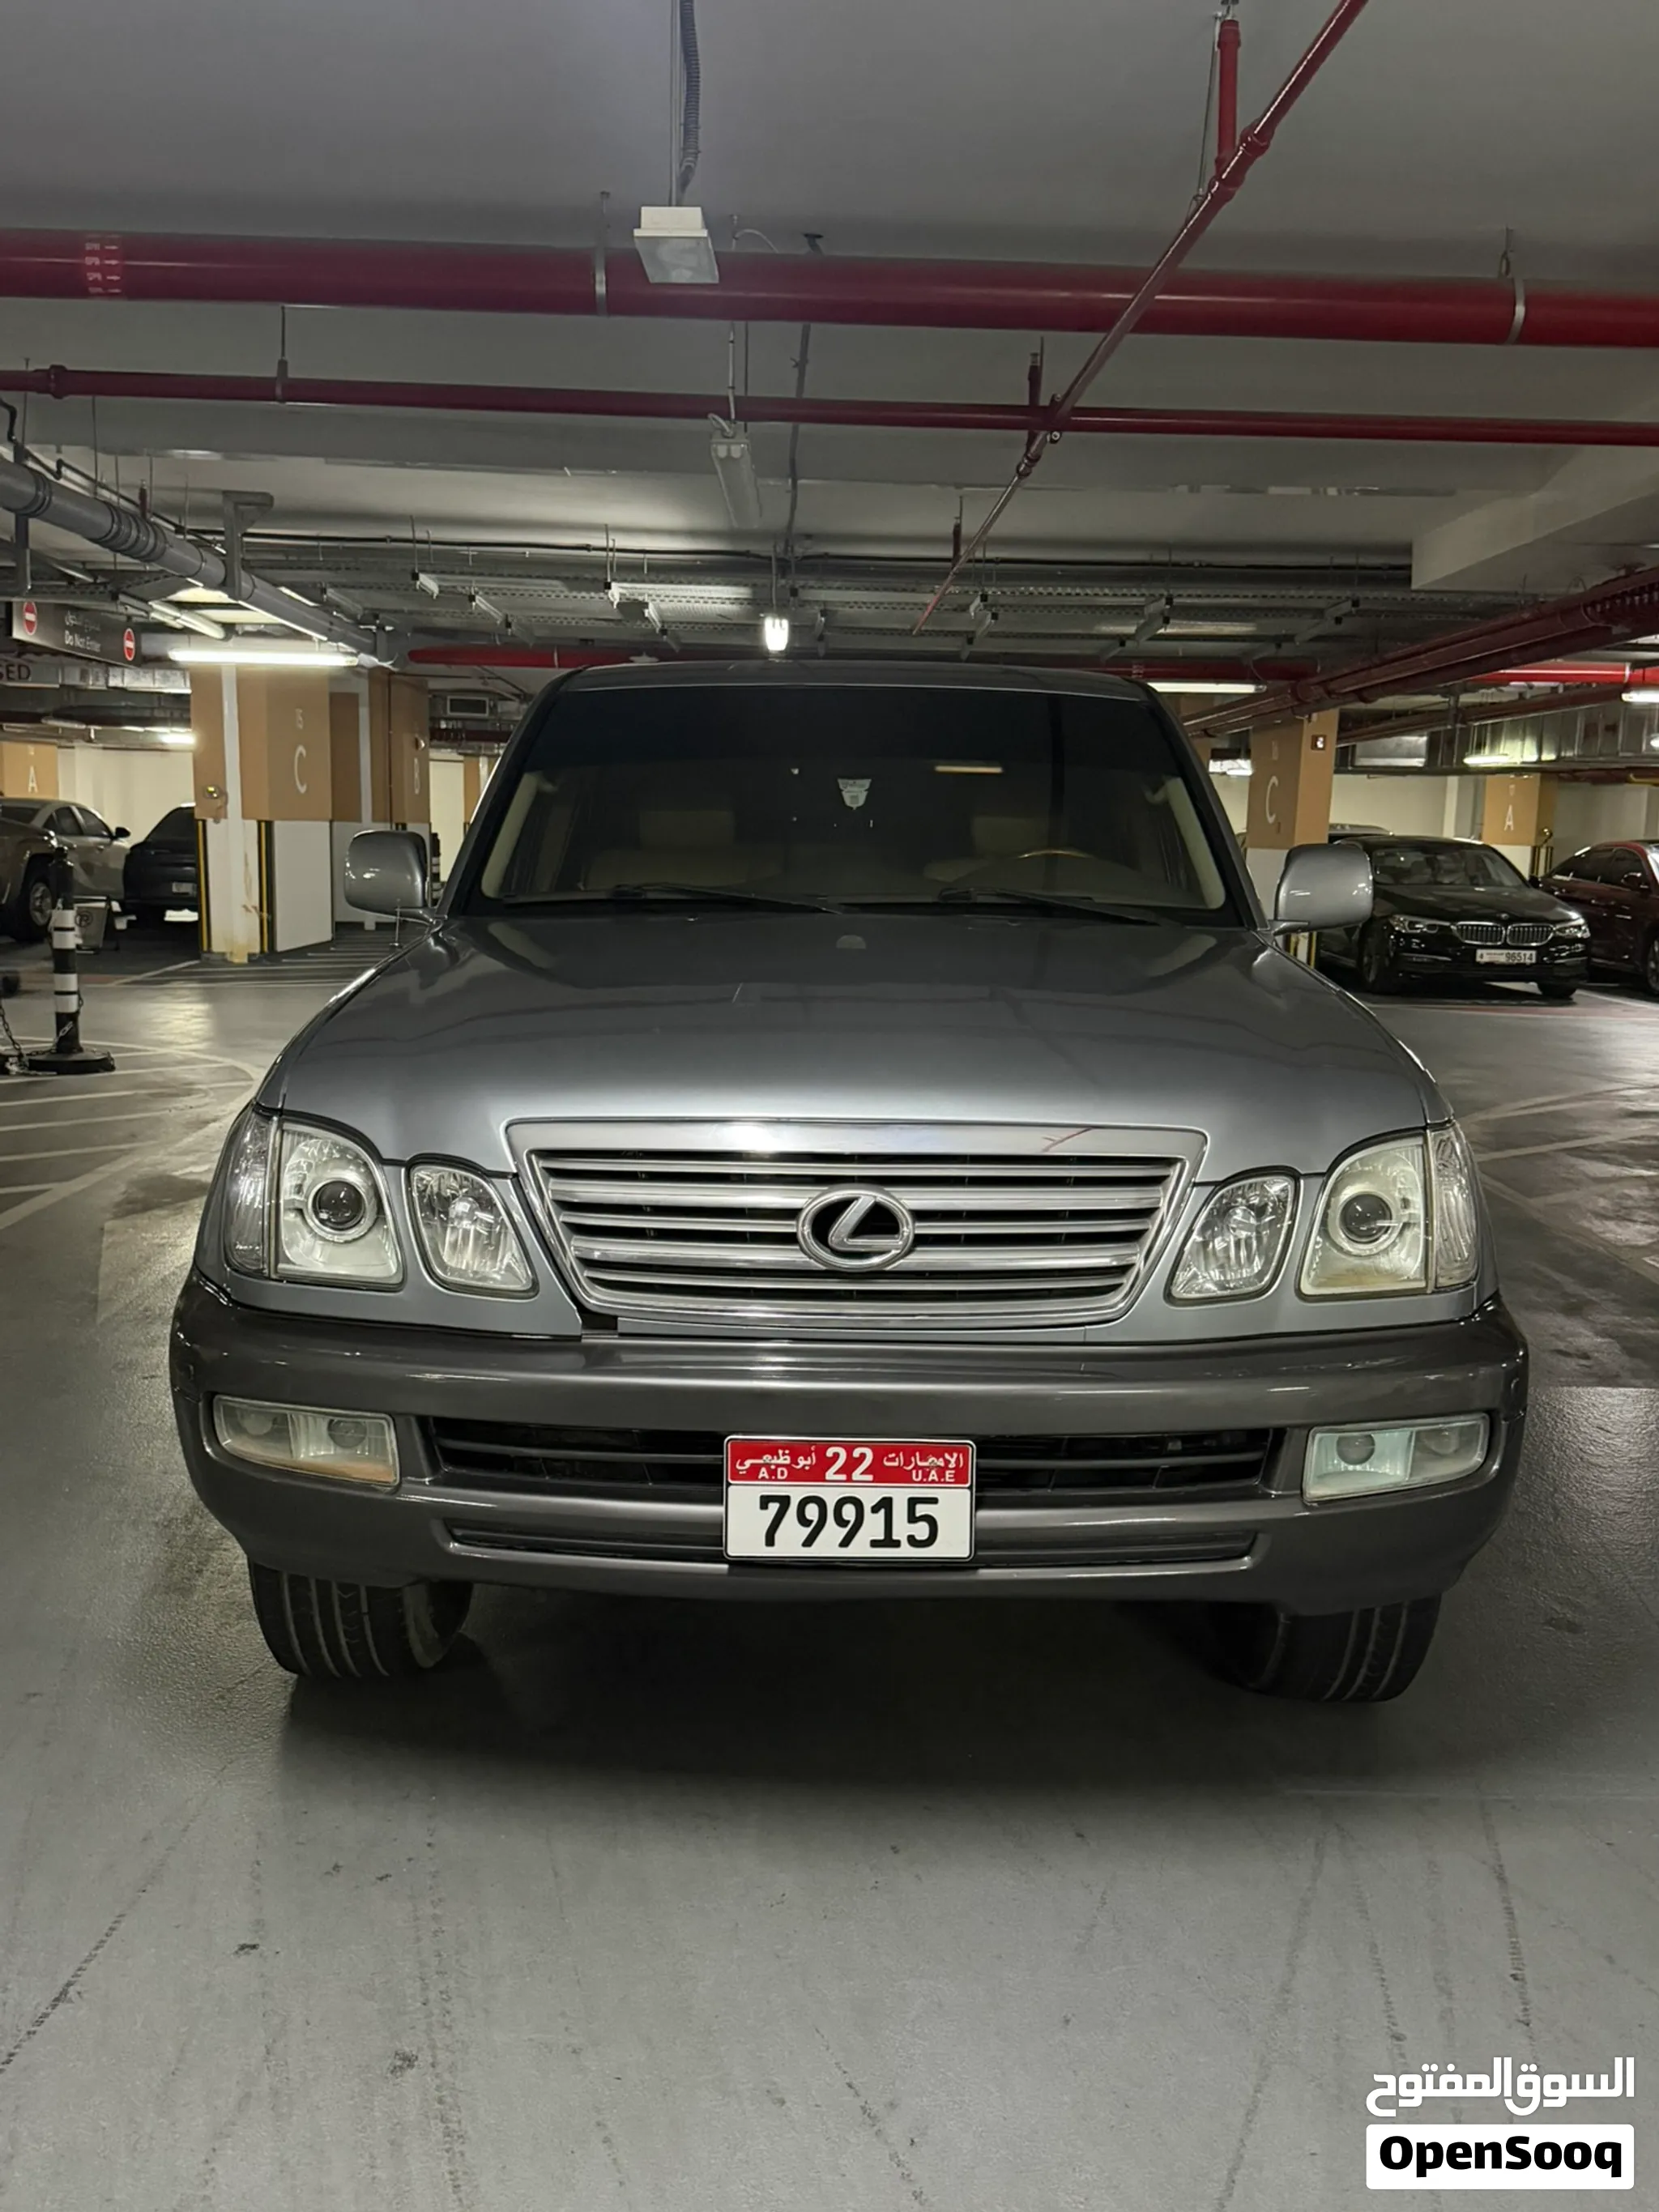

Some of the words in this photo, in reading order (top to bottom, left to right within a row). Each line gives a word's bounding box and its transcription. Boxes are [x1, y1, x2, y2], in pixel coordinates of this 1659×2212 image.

[64, 629, 74, 646] Do
[28, 765, 39, 793] A
[294, 744, 307, 794] C
[1265, 775, 1278, 825] C
[1503, 804, 1514, 831] A
[1505, 951, 1533, 962] 96514
[757, 1467, 788, 1481] A.D
[825, 1446, 874, 1482] 22
[911, 1469, 956, 1482] U.A.E
[759, 1494, 939, 1549] 79915
